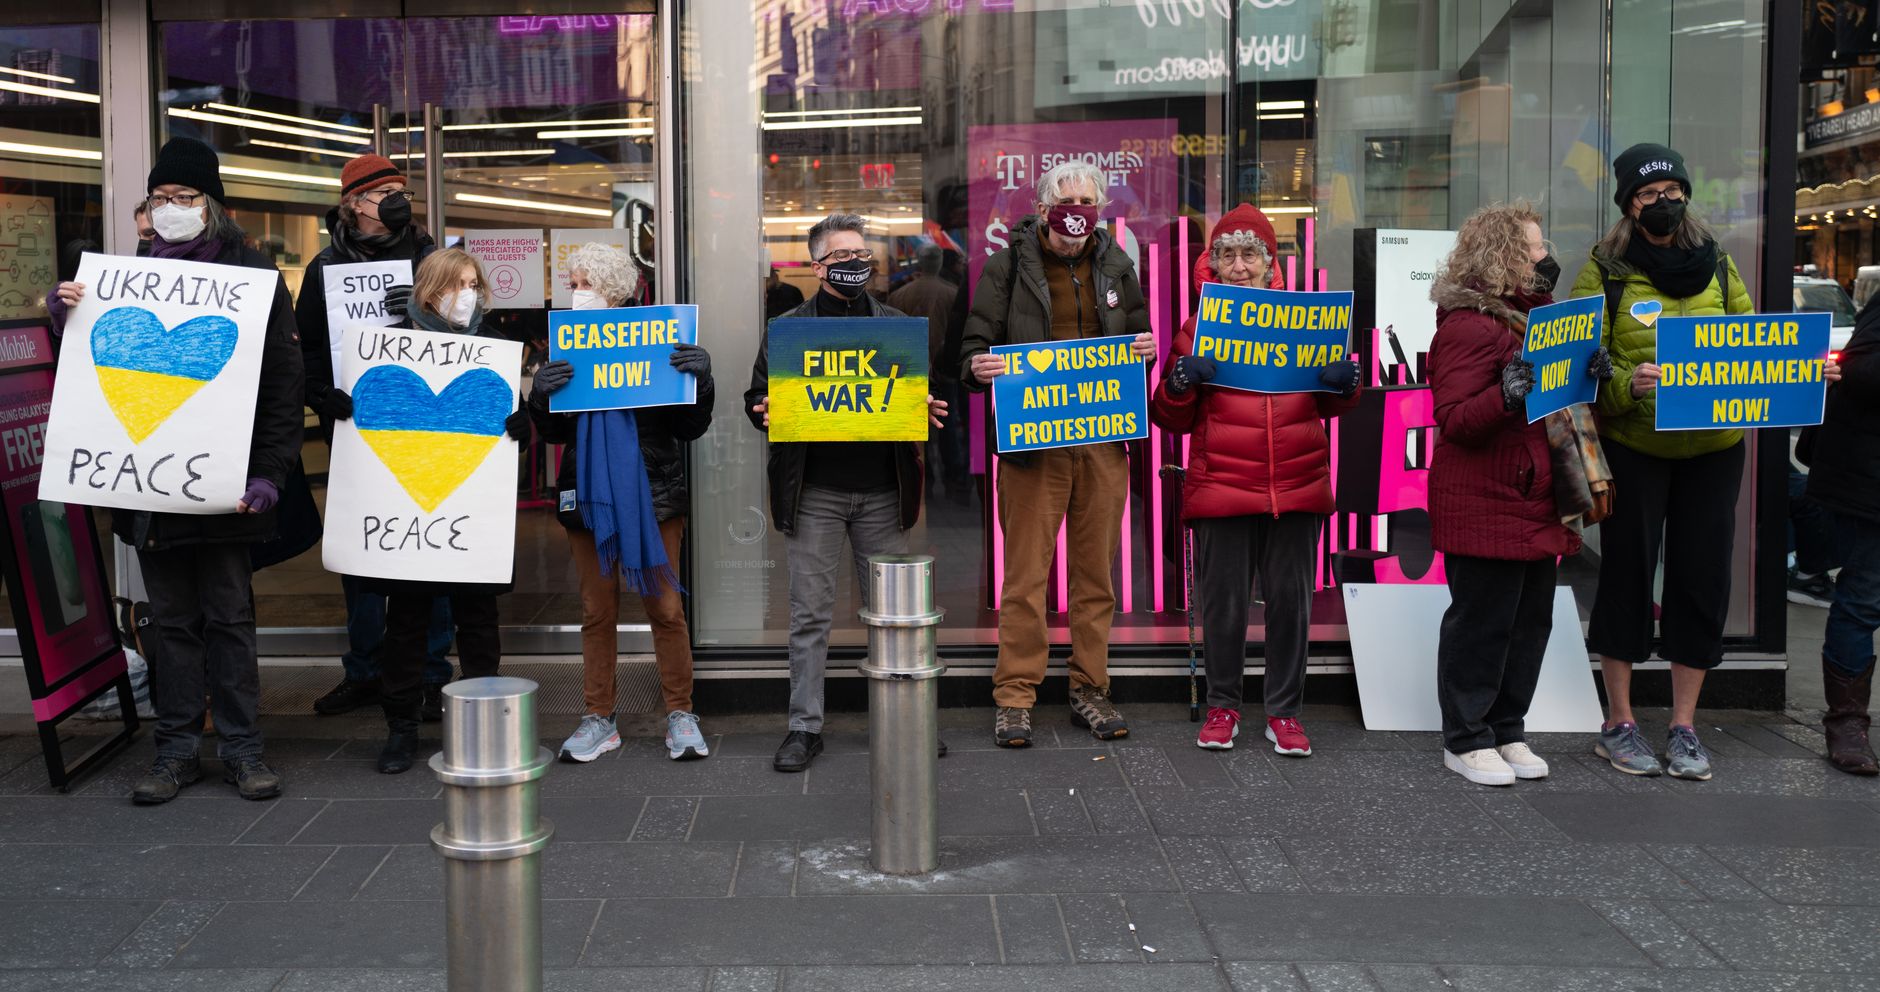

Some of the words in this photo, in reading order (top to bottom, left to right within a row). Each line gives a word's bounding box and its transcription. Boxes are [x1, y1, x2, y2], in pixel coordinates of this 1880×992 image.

[1847, 109, 1872, 131] HEARD
[1639, 161, 1674, 176] RESIST
[512, 238, 540, 246] HIGHLY
[1381, 236, 1409, 245] SAMSUNG
[343, 273, 395, 293] STOP
[831, 272, 841, 281] I'M
[1410, 270, 1436, 281] Galaxy
[96, 269, 250, 313] UKRAINE
[1202, 296, 1234, 324] WE
[1240, 301, 1351, 330] CONDEMN
[557, 318, 679, 350] CEASEFIRE
[1528, 312, 1596, 353] CEASEFIRE
[1694, 321, 1799, 348] NUCLEAR
[358, 331, 492, 365] UKRAINE
[803, 348, 878, 377] FUCK
[1055, 342, 1142, 372] RUSSIAN
[1199, 335, 1289, 368] PUTIN'S
[1296, 344, 1344, 368] WAR
[593, 360, 651, 389] NOW!
[1541, 358, 1572, 393] NOW!
[1660, 358, 1826, 388] DISARMAMENT
[805, 364, 899, 413] WAR!
[1022, 378, 1121, 410] ANTI-WAR
[0, 408, 18, 424] SUNG
[17, 404, 42, 420] GALAXY
[1712, 398, 1770, 424] NOW!
[1009, 411, 1137, 446] PROTESTORS
[68, 448, 211, 502] PEACE
[363, 515, 470, 552] PEACE
[713, 559, 743, 569] STORE
[744, 559, 776, 569] HOURS
